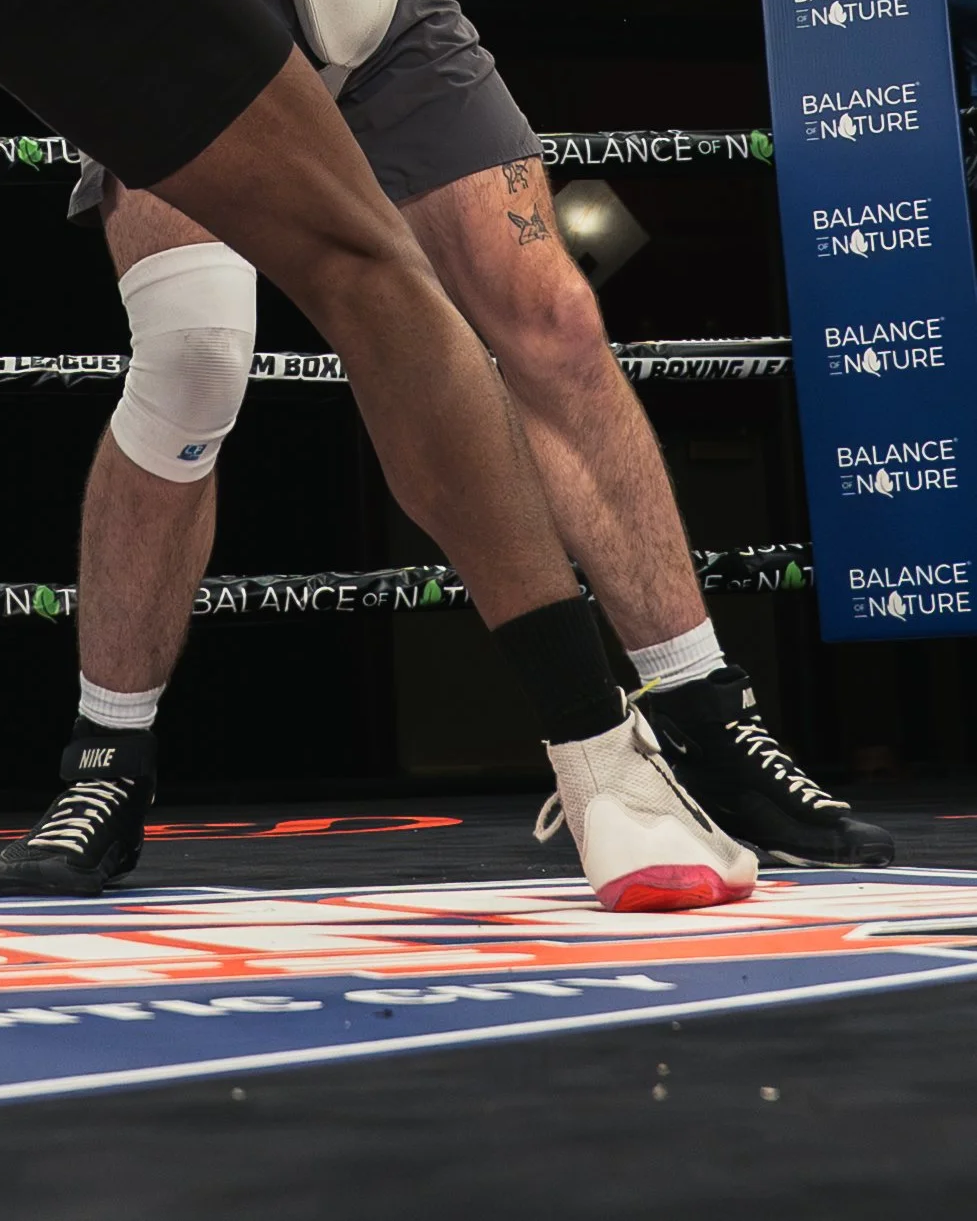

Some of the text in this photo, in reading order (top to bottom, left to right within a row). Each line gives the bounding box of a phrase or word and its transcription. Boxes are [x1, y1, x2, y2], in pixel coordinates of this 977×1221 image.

[802, 83, 917, 115] BALANCE
[540, 136, 693, 165] BALANCE
[698, 140, 721, 154] OF
[813, 199, 929, 230] BALANCE
[825, 318, 942, 348] BALANCE
[14, 355, 120, 372] LEAGUE
[284, 356, 346, 378] BOX
[650, 360, 744, 379] BOXING
[837, 439, 955, 468] BALANCE
[849, 563, 969, 590] BALANCE
[5, 585, 77, 623] NAT
[192, 586, 357, 614] BALANCE
[362, 593, 388, 607] OF
[79, 748, 116, 769] NIKE
[344, 975, 678, 1005] CITY
